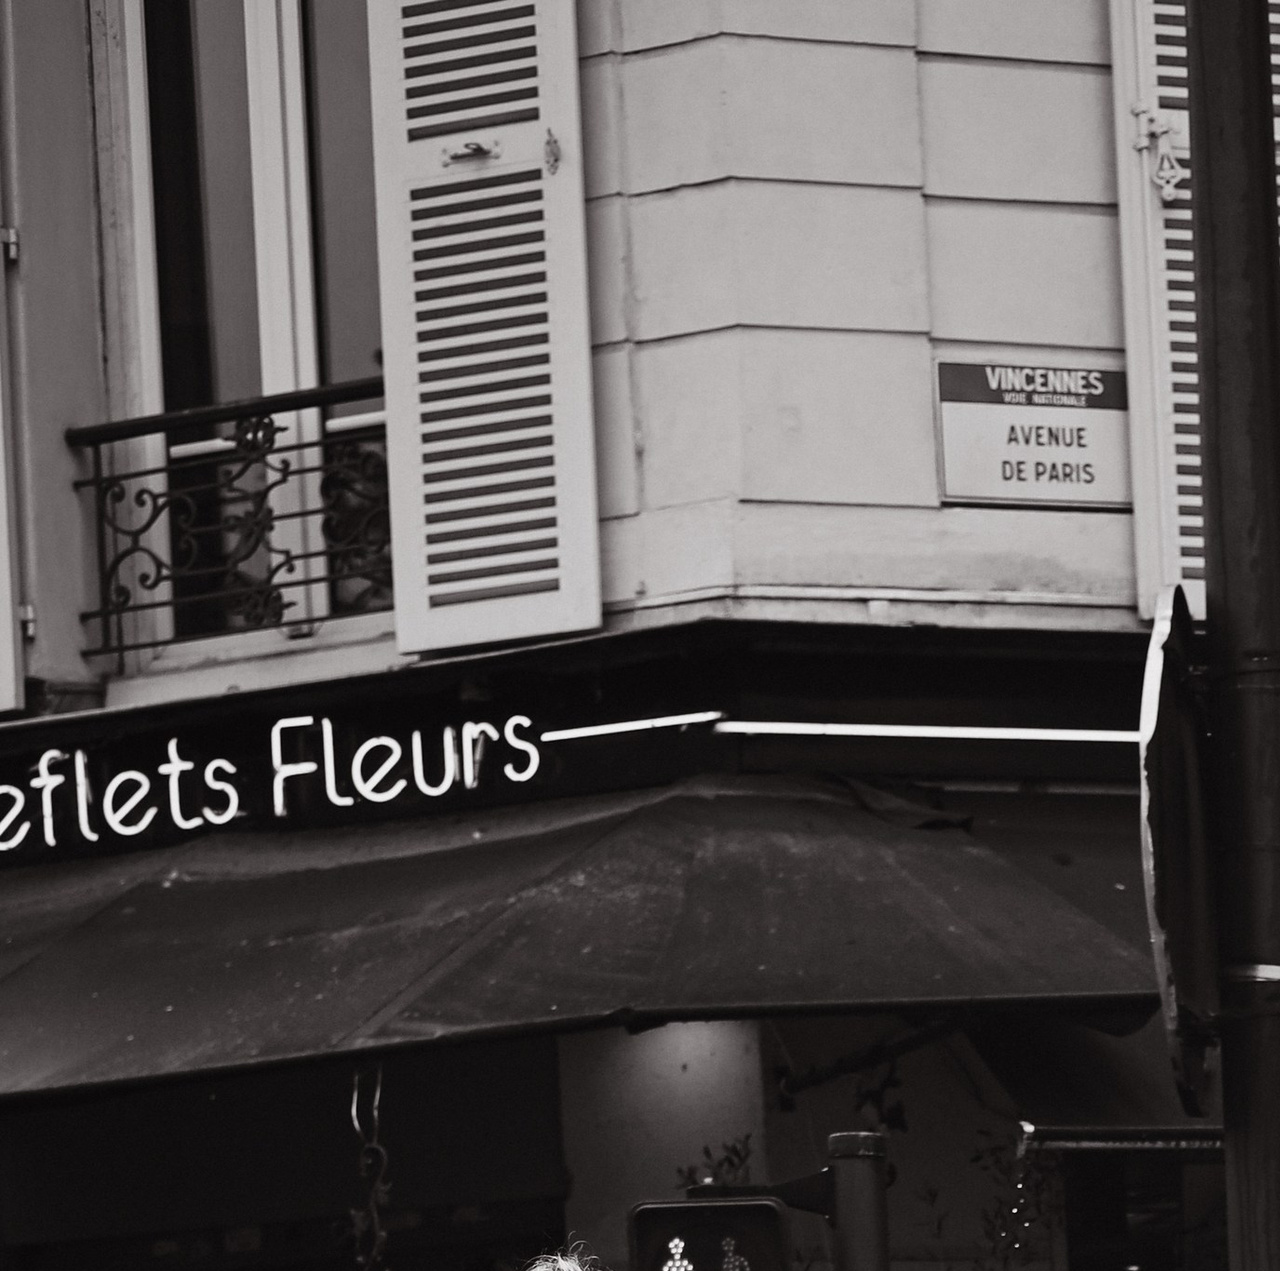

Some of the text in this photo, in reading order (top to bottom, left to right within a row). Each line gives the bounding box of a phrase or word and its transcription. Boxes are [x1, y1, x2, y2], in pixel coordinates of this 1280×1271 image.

[985, 366, 1104, 395] VINCENNES
[1007, 425, 1088, 448] AVENUE
[1002, 461, 1095, 484] DE PARIS
[271, 715, 541, 817] Fleurs
